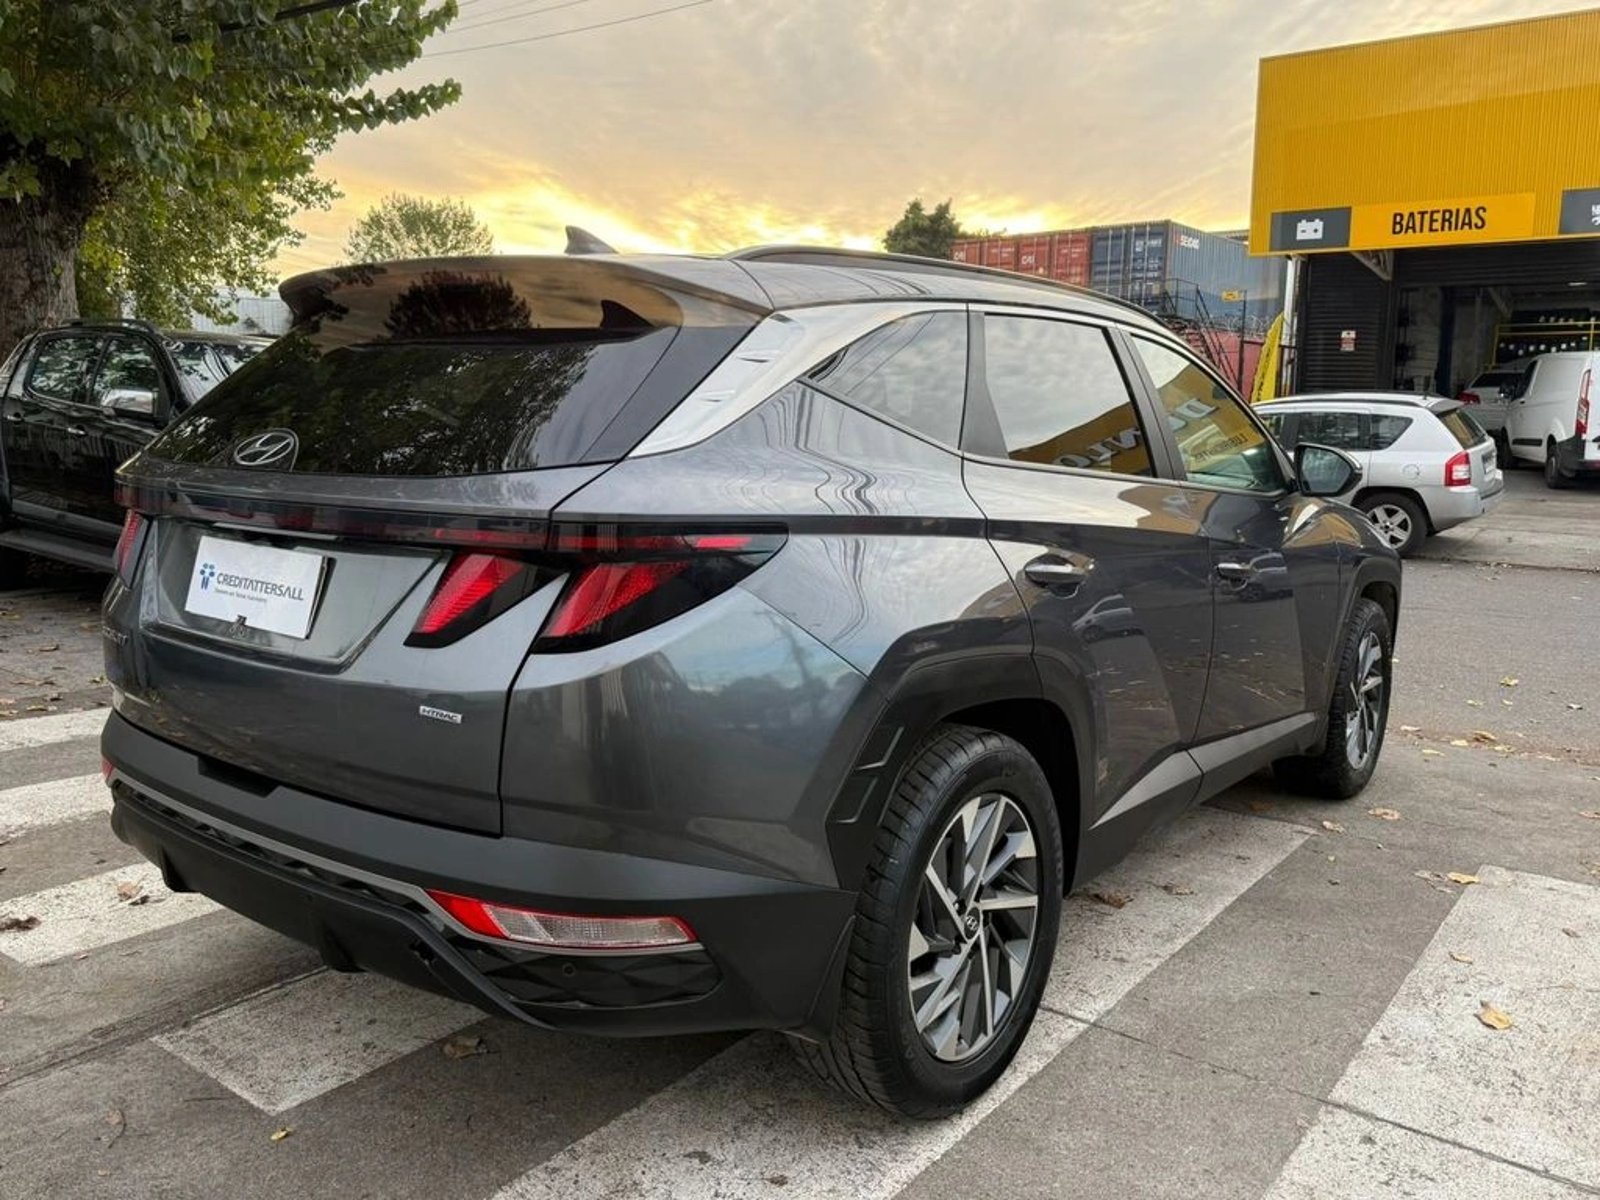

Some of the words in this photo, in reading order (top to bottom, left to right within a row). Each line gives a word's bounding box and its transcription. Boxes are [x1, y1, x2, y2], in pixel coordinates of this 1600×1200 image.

[1392, 206, 1487, 234] BATERIAS
[216, 572, 304, 601] CREDITATTERSALL
[422, 707, 458, 722] HTRAC
